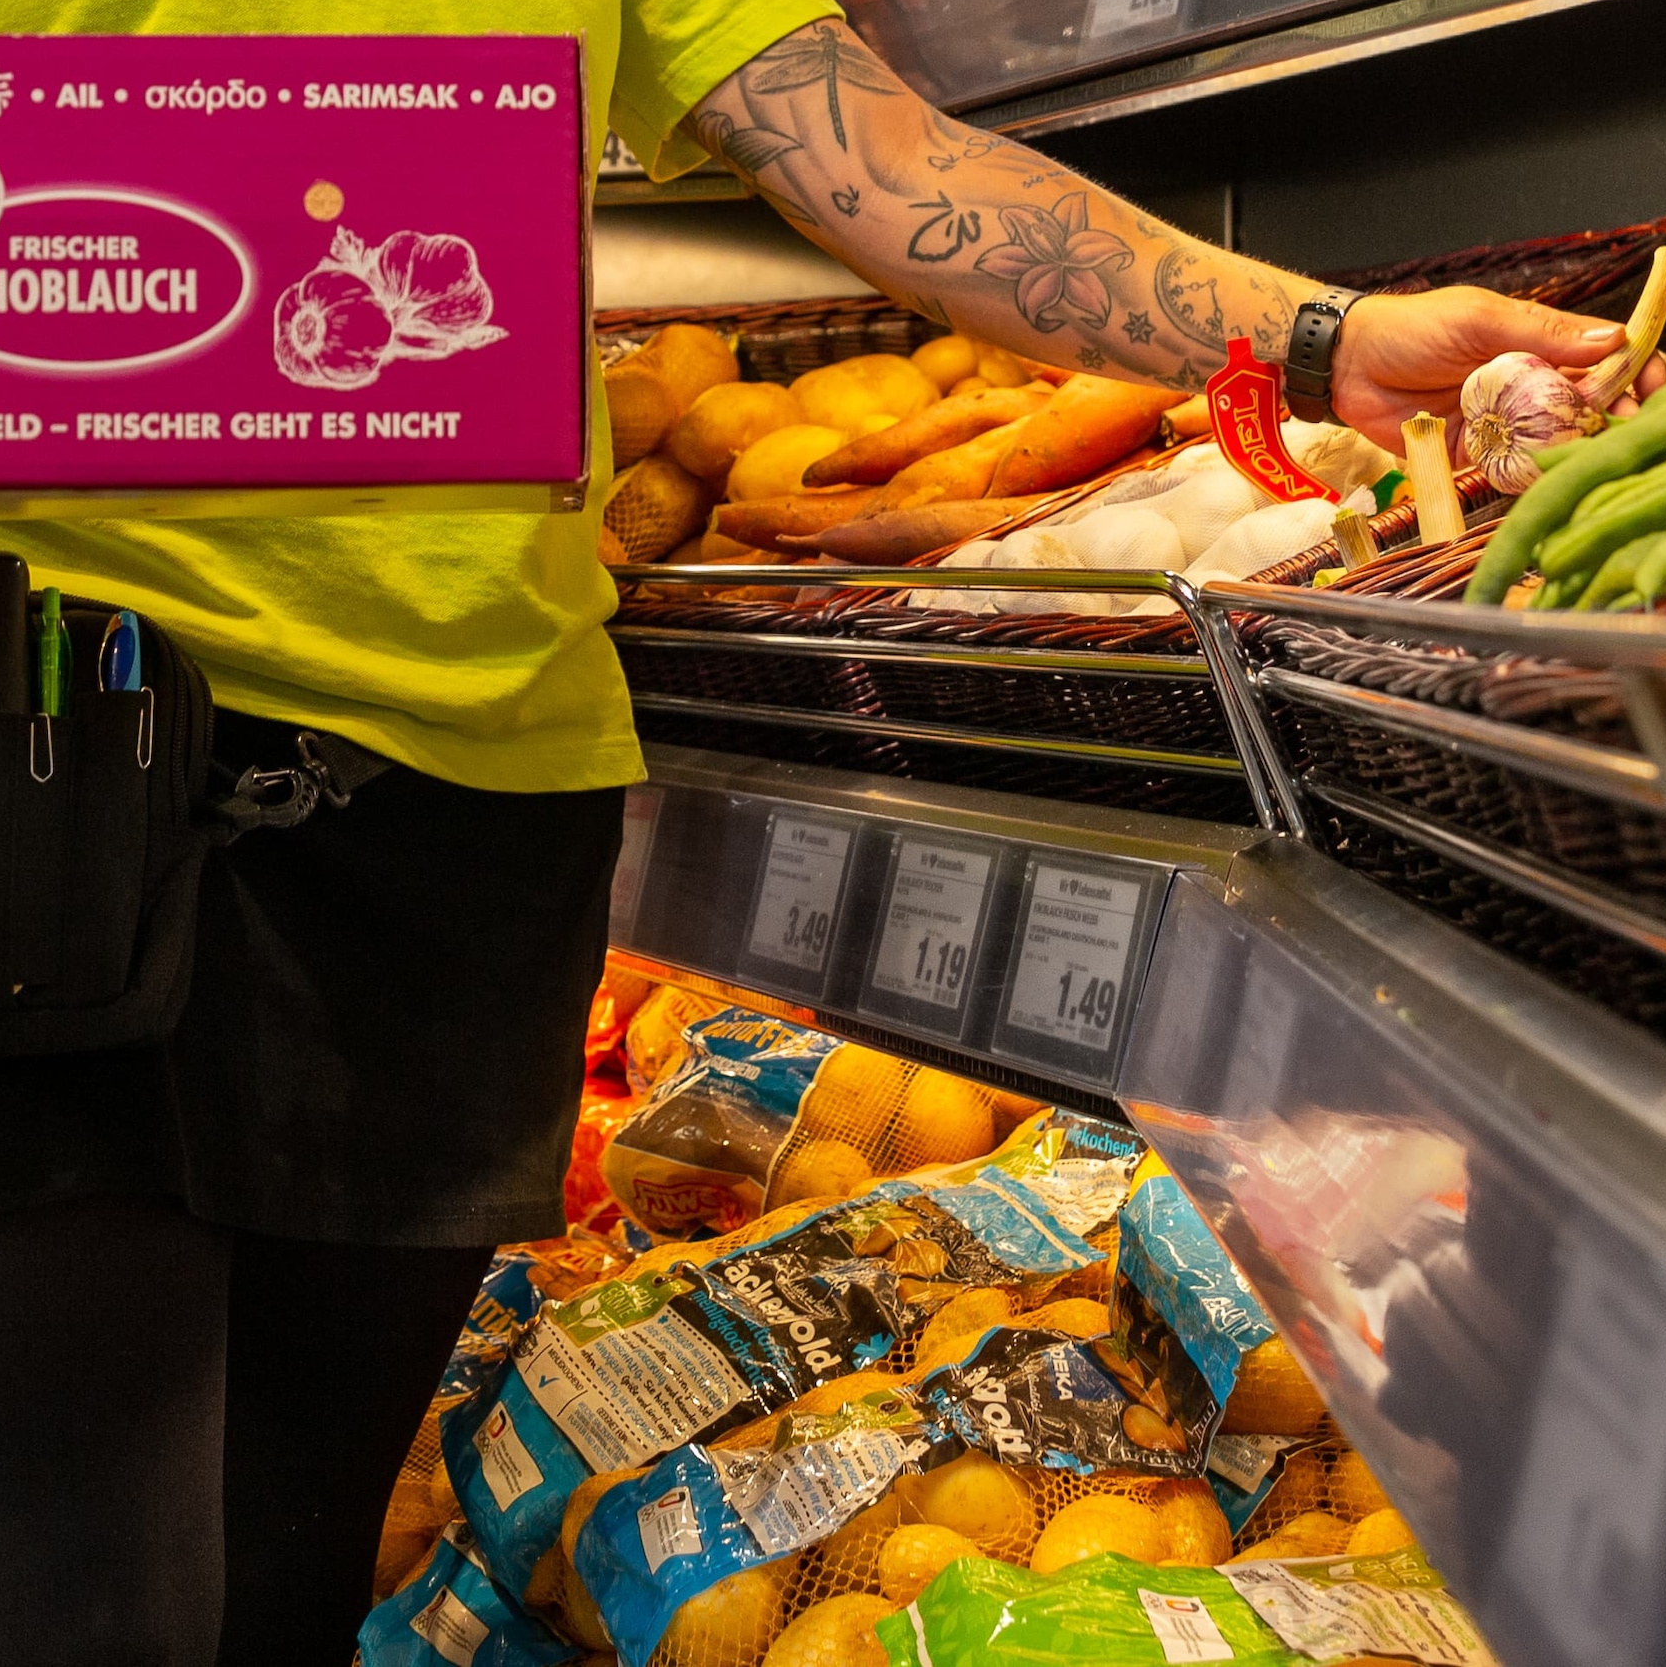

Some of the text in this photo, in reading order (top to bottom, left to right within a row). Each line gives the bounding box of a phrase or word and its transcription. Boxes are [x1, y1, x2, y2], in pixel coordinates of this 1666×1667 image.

[56, 83, 103, 109] AIL
[145, 79, 267, 115] σκόρδο
[303, 83, 458, 109] SARIMSAK
[494, 84, 557, 110] AJO
[9, 236, 140, 260] FRISCHER
[76, 412, 221, 439] FRISCHER
[230, 411, 313, 439] GEHT
[321, 411, 356, 439] ES
[366, 411, 461, 439] NICHT
[783, 905, 829, 954] 3.49
[914, 936, 967, 989] 1.19
[1057, 970, 1116, 1029] 1.49
[602, 1287, 633, 1319] ERNTE
[642, 1380, 657, 1395] Sie
[653, 1393, 675, 1418] haben
